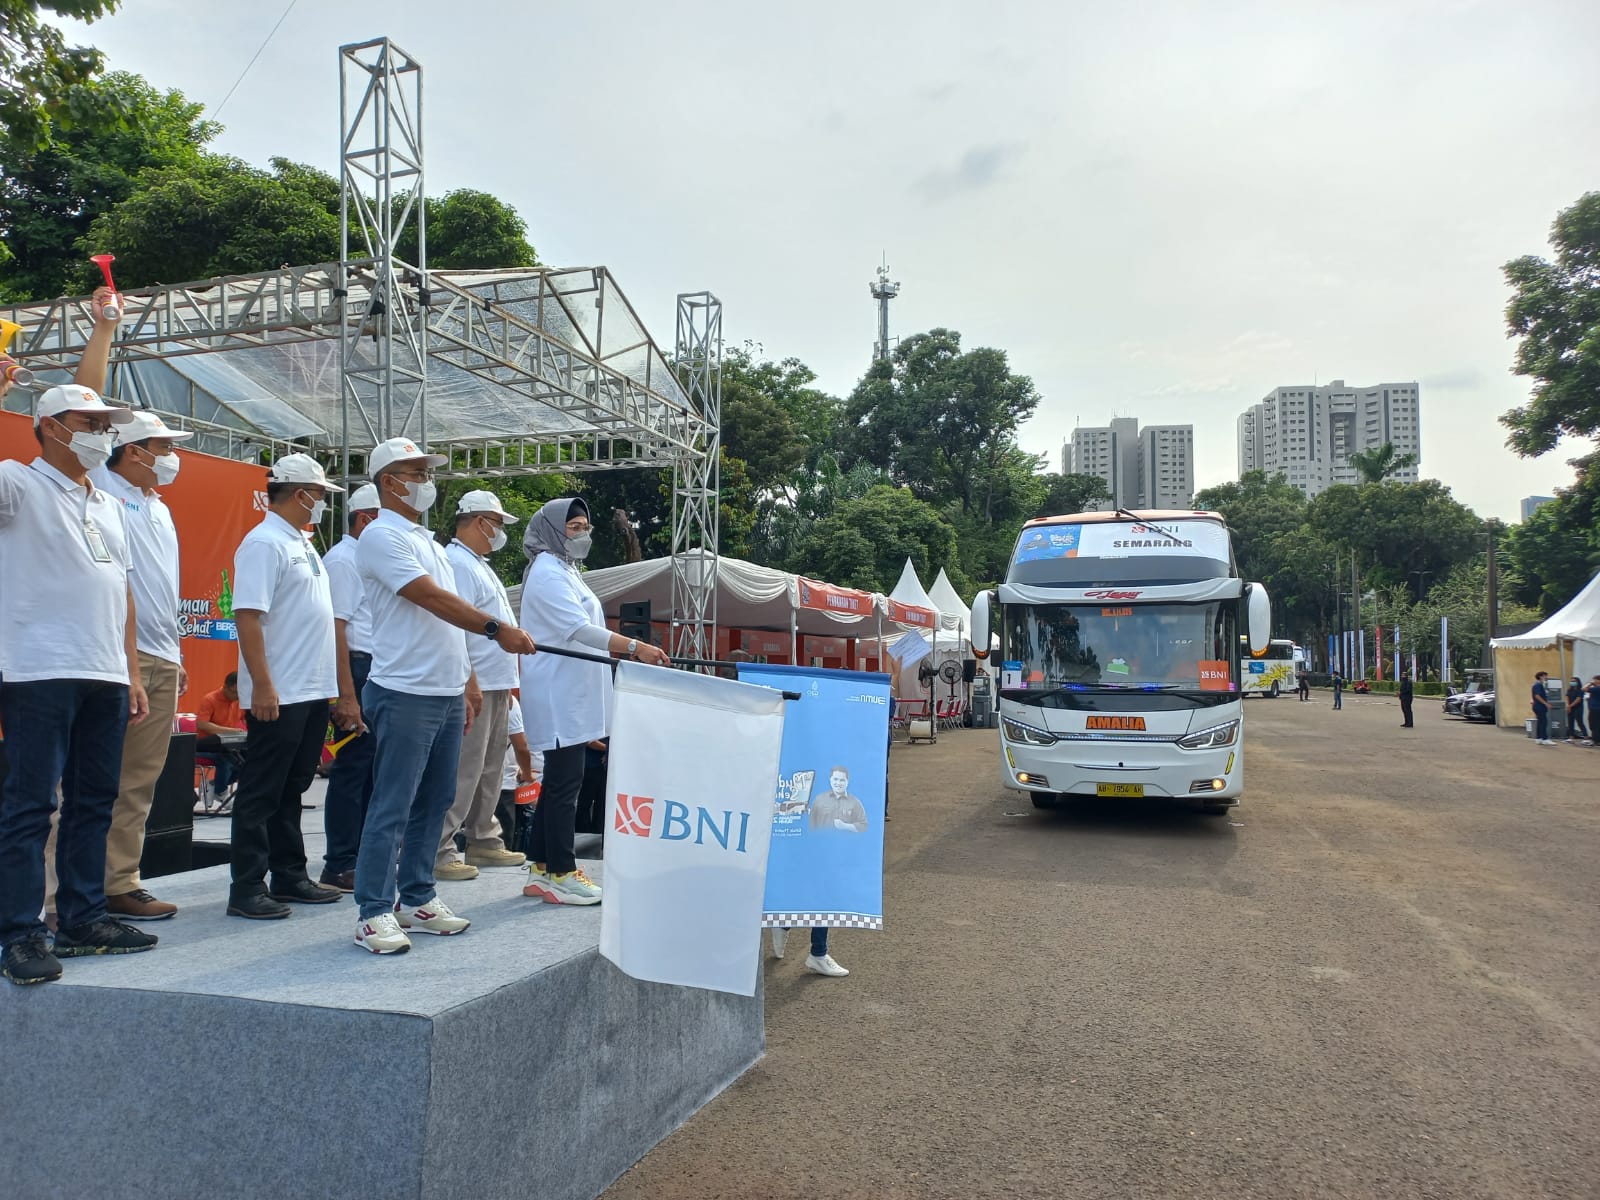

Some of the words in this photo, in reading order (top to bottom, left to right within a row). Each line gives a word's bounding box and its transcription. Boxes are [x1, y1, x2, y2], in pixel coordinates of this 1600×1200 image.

[126, 502, 139, 511] BNI
[1113, 539, 1193, 548] SEMARANG
[178, 599, 209, 613] man
[177, 615, 213, 636] Sehat
[216, 621, 236, 631] BERS
[1210, 671, 1227, 679] BNI
[1086, 715, 1147, 731] AMALIA
[659, 799, 751, 853] BNI
